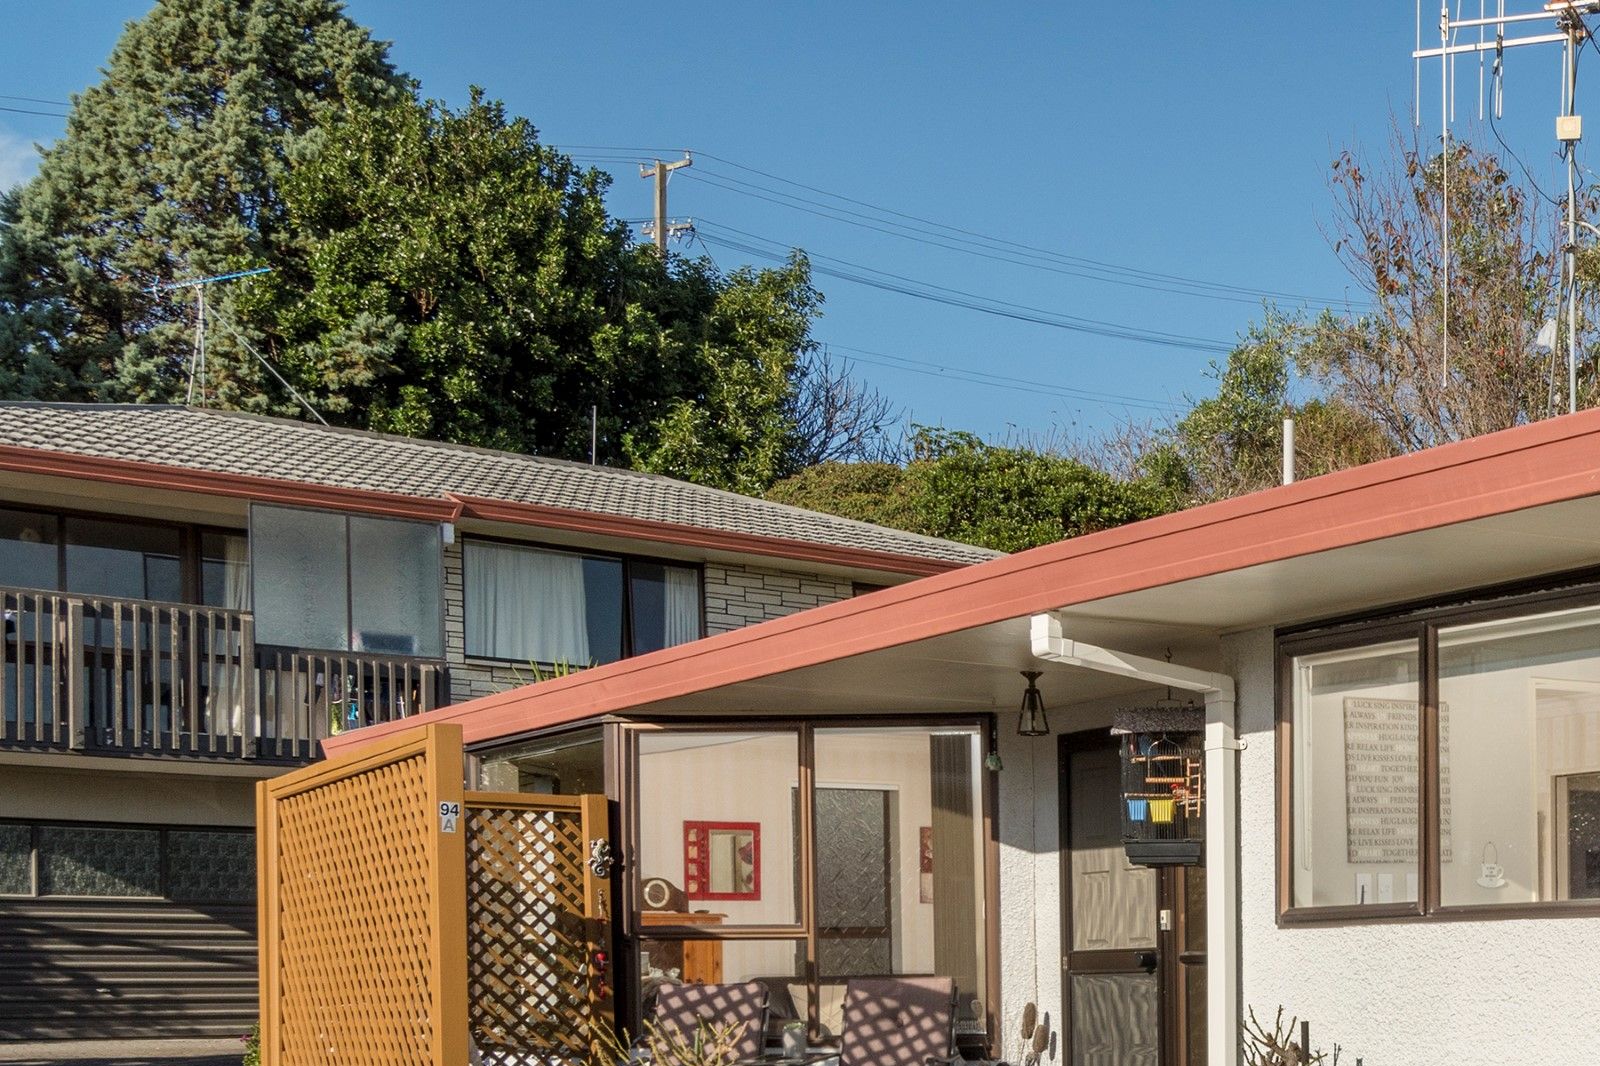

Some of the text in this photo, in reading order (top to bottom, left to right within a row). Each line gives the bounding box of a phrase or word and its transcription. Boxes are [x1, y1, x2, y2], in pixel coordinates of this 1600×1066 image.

[1350, 712, 1376, 720] ALWAYS
[1352, 796, 1378, 804] ALWAYS
[440, 803, 459, 816] 94
[443, 819, 454, 831] A
[1358, 828, 1380, 836] RELAX
